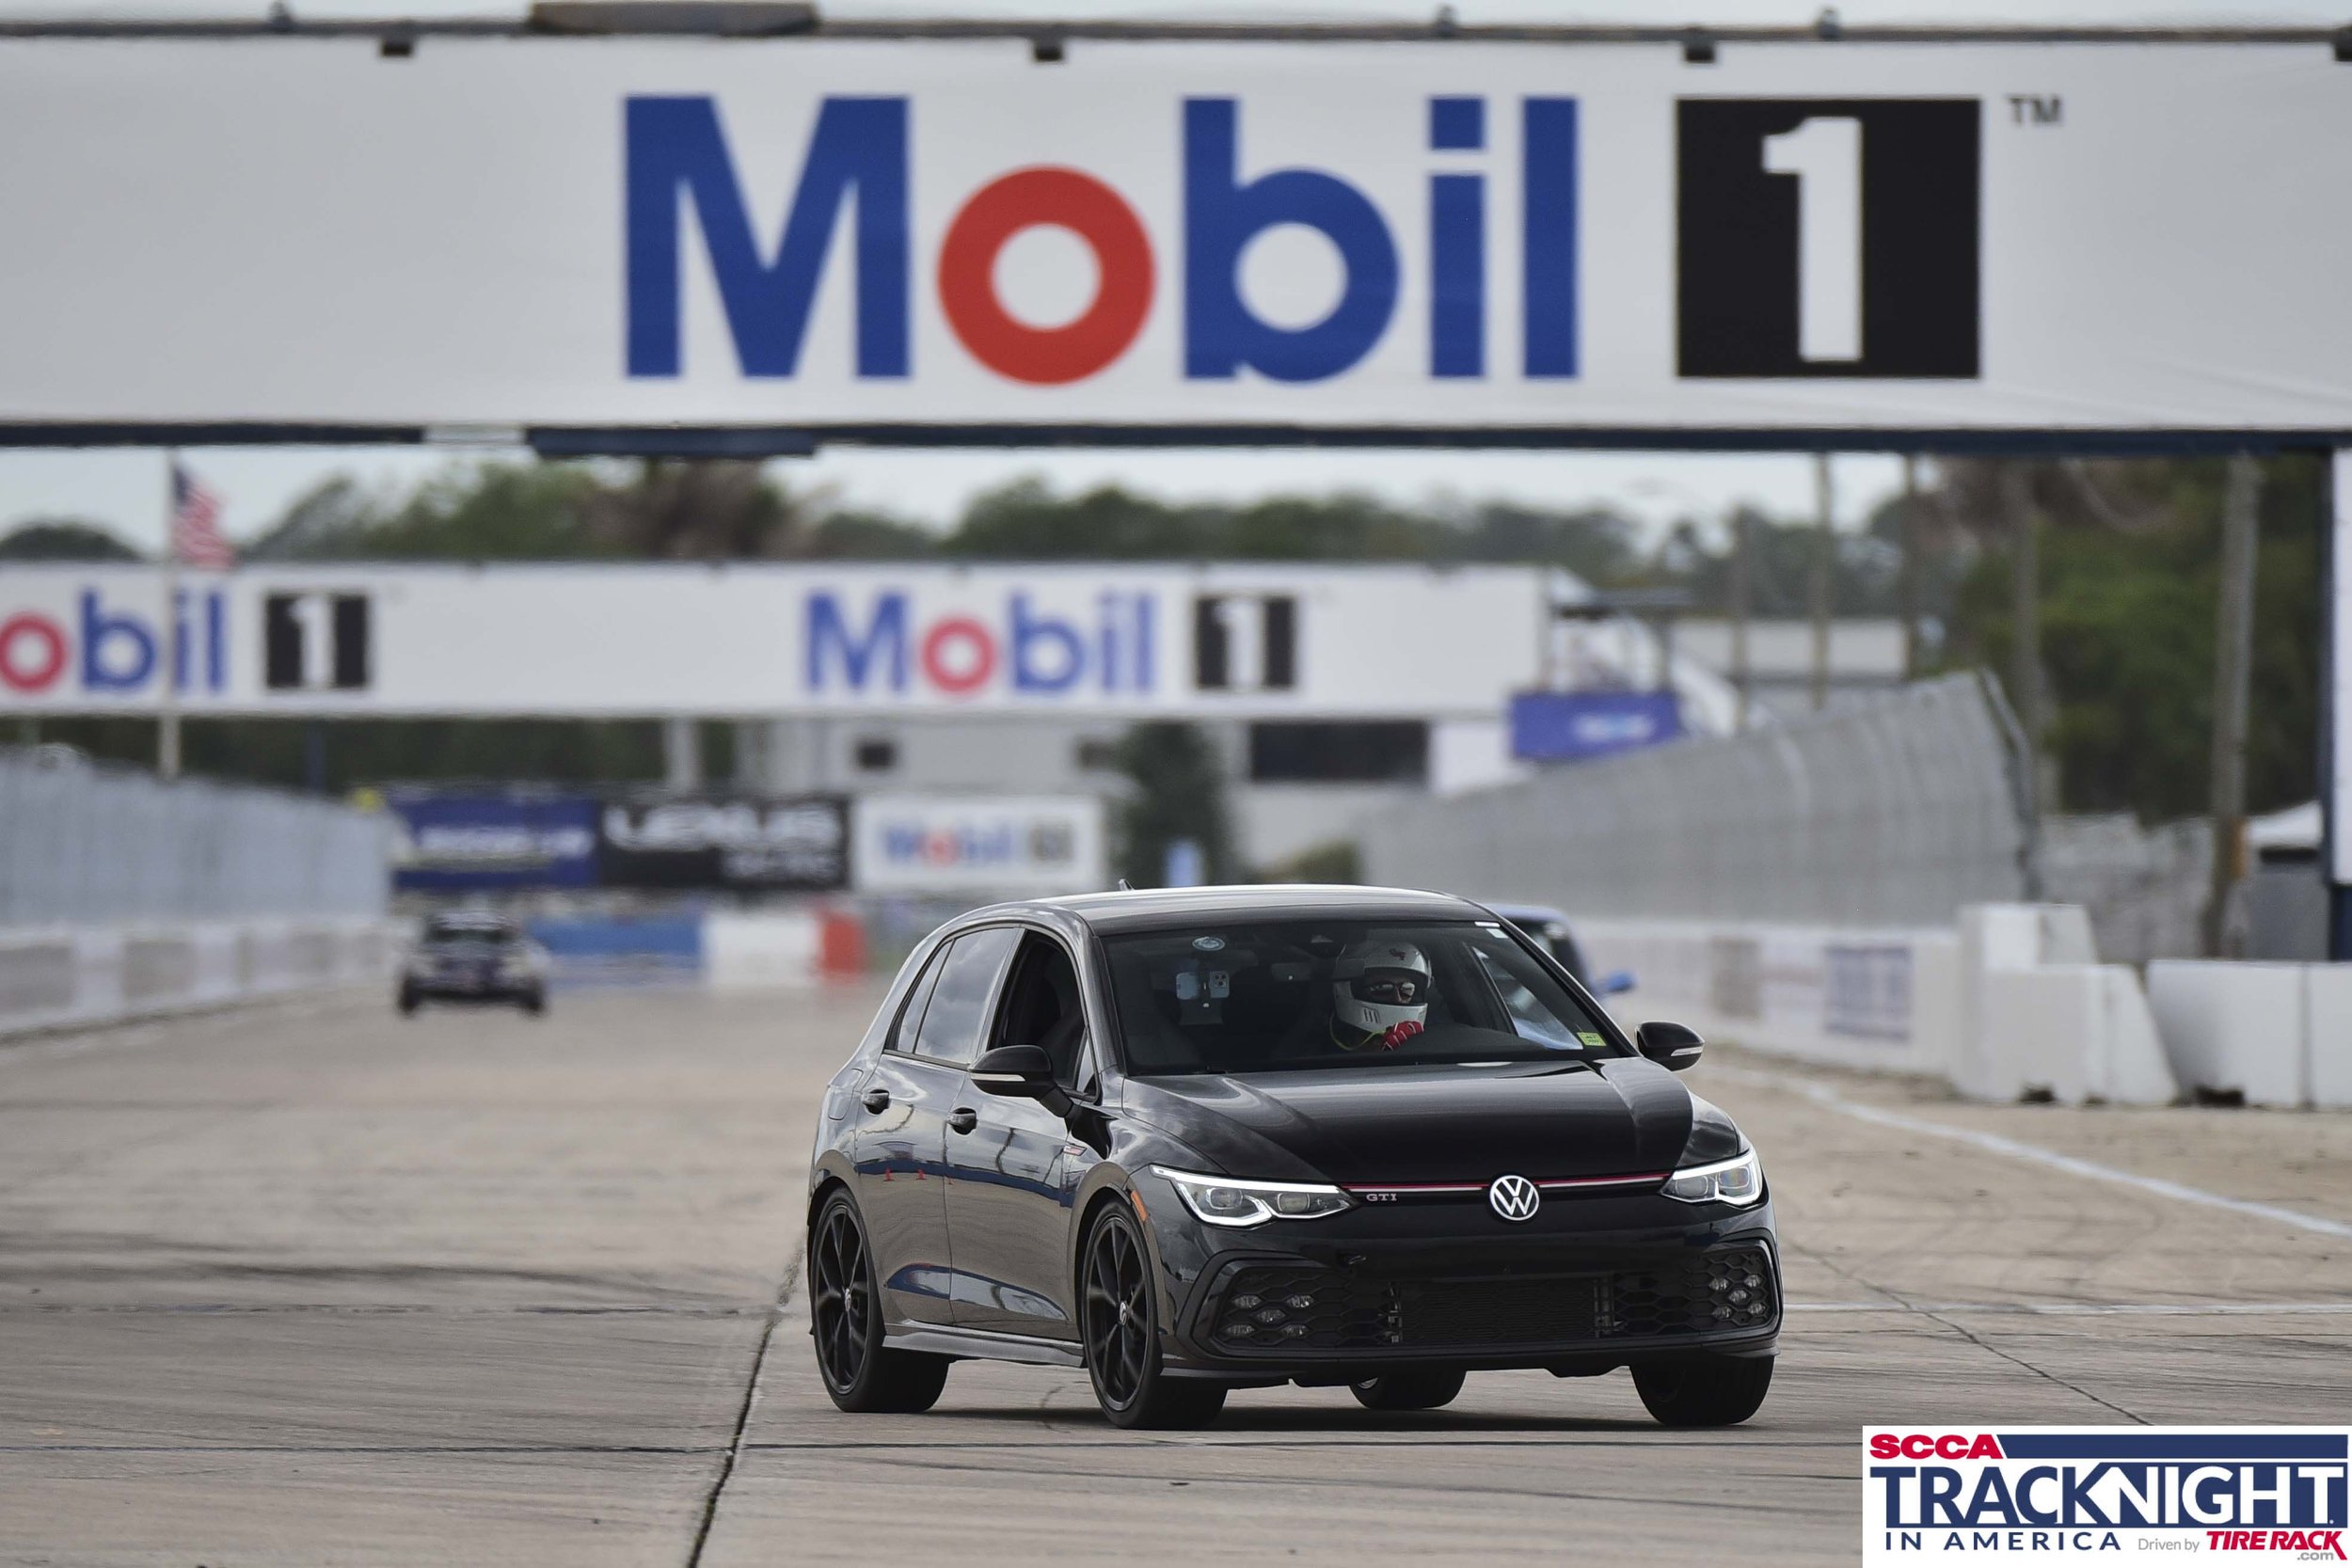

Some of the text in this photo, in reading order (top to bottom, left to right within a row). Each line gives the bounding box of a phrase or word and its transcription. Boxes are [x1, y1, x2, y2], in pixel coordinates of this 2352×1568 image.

[624, 96, 1579, 386] Mobil
[1763, 116, 1862, 361] 1
[288, 597, 331, 685] 1
[805, 592, 1156, 695] Mobil
[1366, 1193, 1398, 1202] GTI
